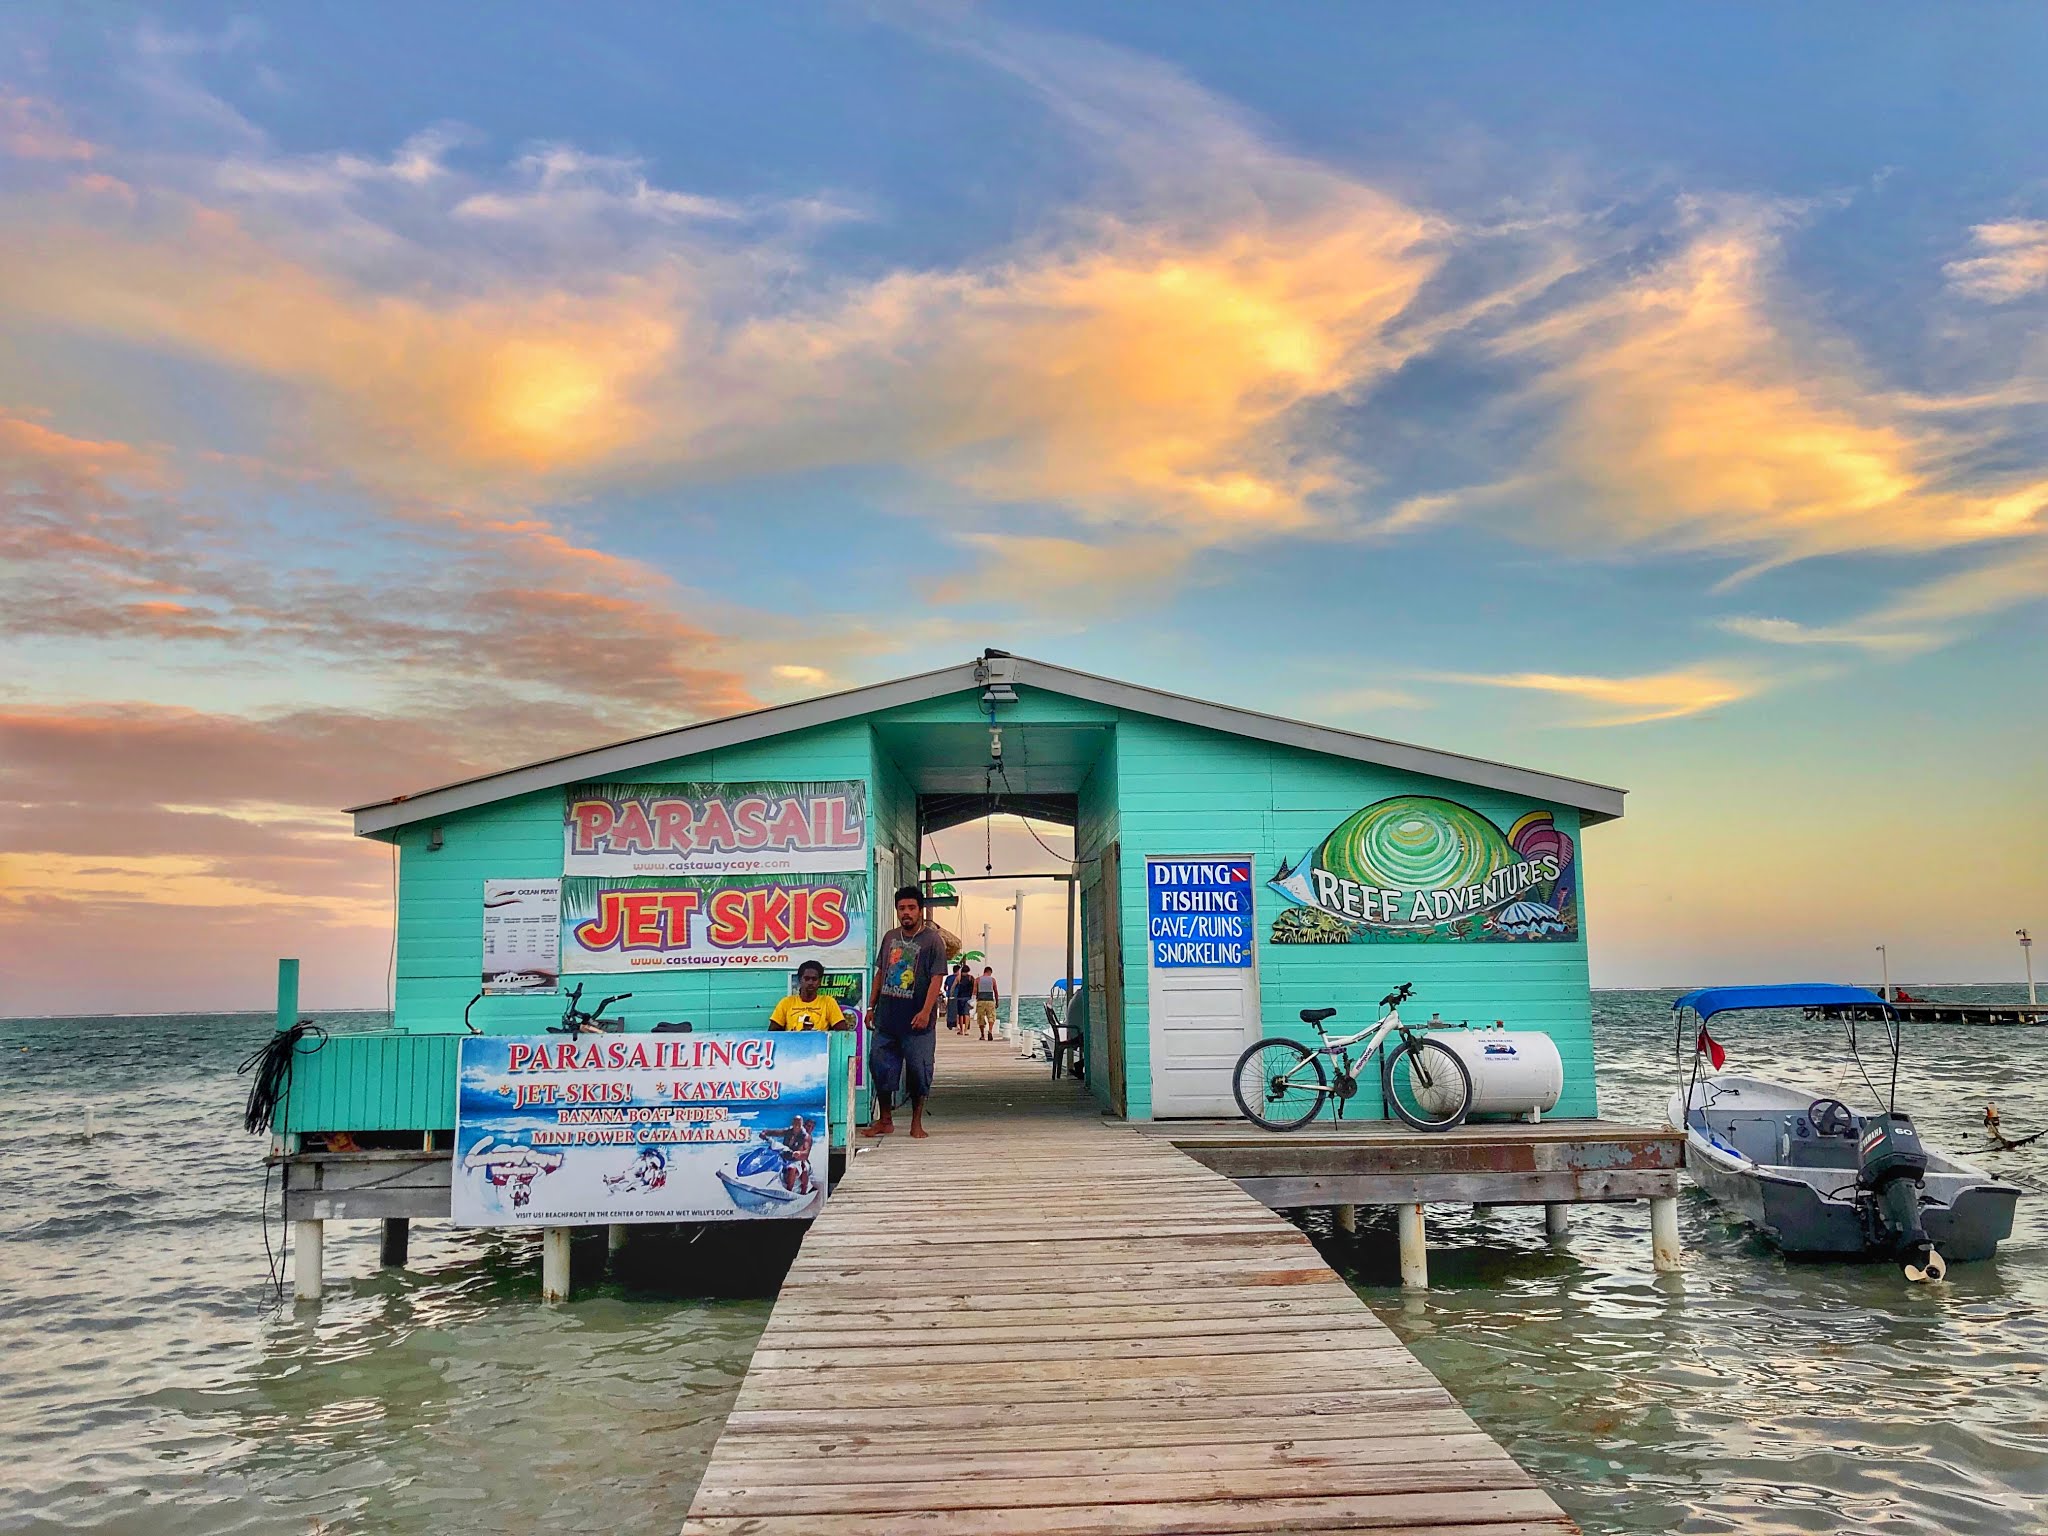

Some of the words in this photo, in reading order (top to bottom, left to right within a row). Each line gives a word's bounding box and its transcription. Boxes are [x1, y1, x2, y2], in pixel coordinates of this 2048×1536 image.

[568, 796, 864, 857] PARASAIL
[633, 859, 791, 872] www.castawaycaye.com
[1154, 865, 1231, 885] DIVING
[1313, 868, 1402, 922] REEF
[1409, 855, 1561, 922] ADVENTURES
[1161, 891, 1238, 911] FISHING
[575, 890, 701, 951] JET
[707, 883, 848, 951] SKIS
[1151, 915, 1242, 939] CAVE/RUINS
[630, 953, 789, 967] www.castawaycaye.com
[1158, 942, 1241, 964] SNORKELING
[832, 974, 853, 987] LIMO
[508, 1040, 774, 1072] PARASAILING!
[513, 1082, 633, 1109] JET-SKIS!
[672, 1080, 780, 1101] KAYAKS!
[558, 1109, 625, 1125] BANANA
[627, 1108, 671, 1123] BOAT
[675, 1107, 729, 1122] RIDES!
[532, 1130, 573, 1145] MINI
[575, 1129, 635, 1145] POWER
[638, 1126, 752, 1144] CATAMARANS!
[1860, 1126, 1883, 1152] YAMAHA
